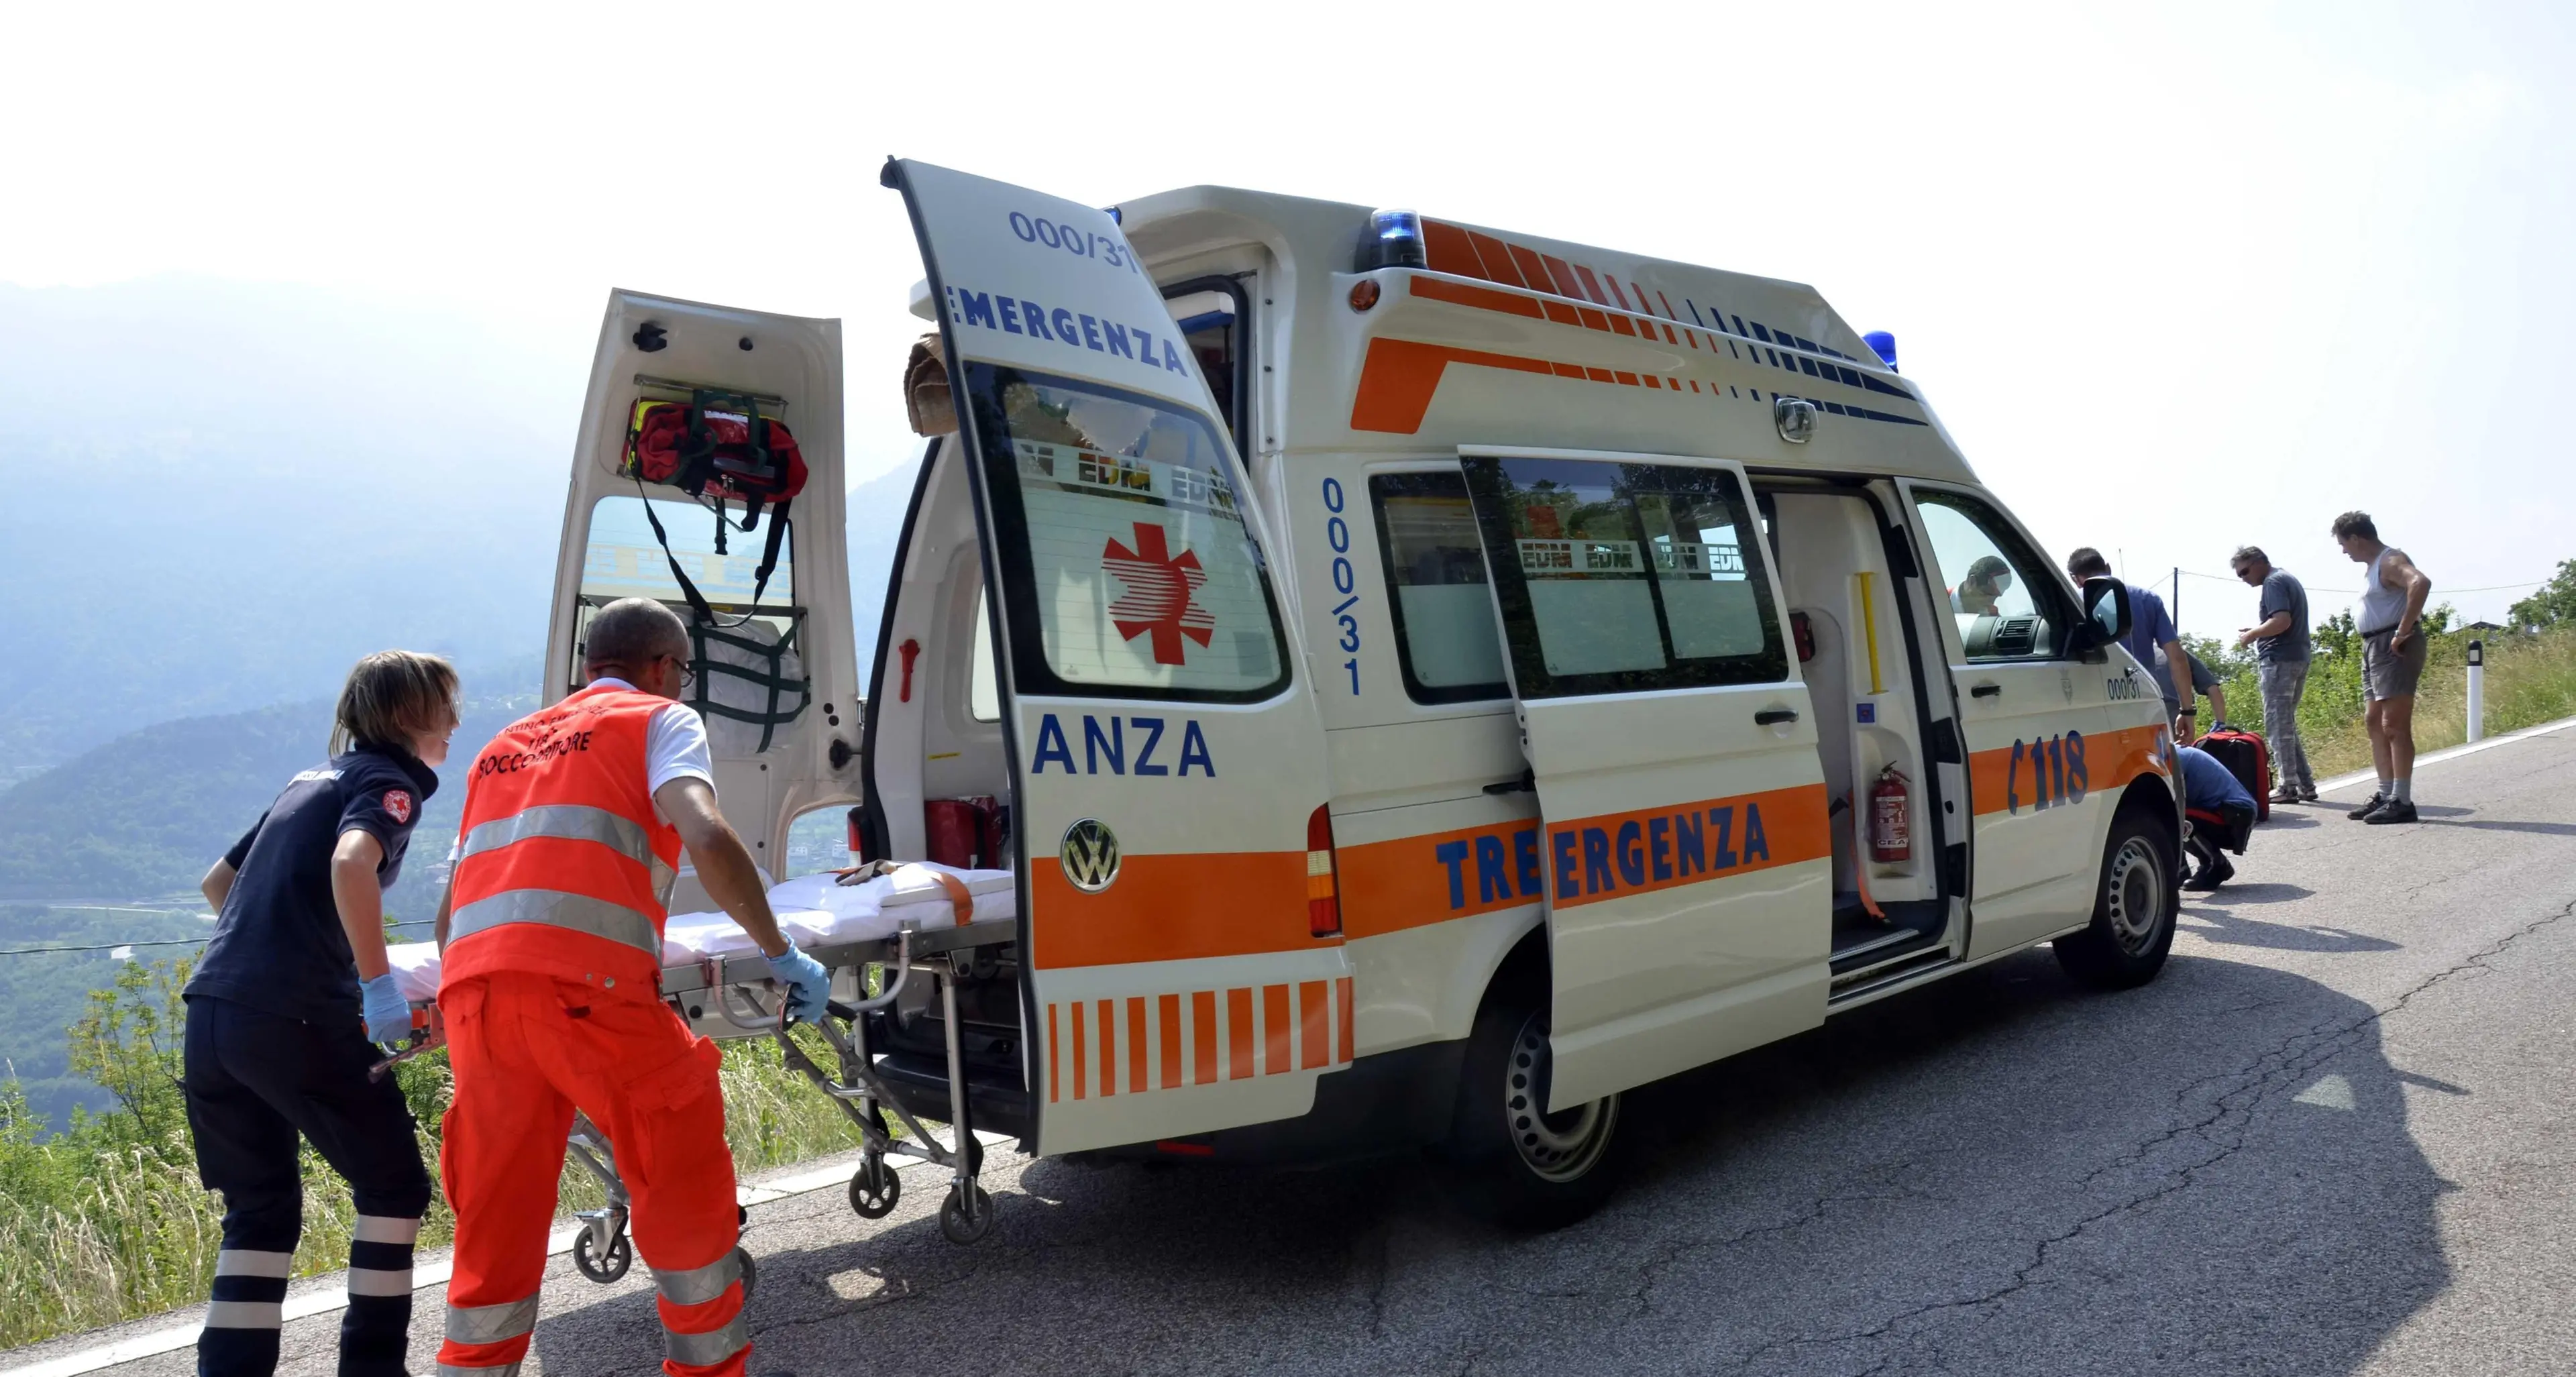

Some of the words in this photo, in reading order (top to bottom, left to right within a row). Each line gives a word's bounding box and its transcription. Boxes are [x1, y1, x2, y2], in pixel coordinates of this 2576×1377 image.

[1009, 211, 1138, 274] 000/31
[1079, 452, 1150, 492] EDM
[1322, 477, 1360, 696] 000/31
[1521, 543, 1572, 568] EDM
[1585, 543, 1633, 568] EDM
[2107, 677, 2141, 700] 000/31
[1031, 714, 1216, 777] ANZA
[2031, 730, 2088, 812] 118
[1436, 829, 1542, 910] TRE
[1553, 803, 1770, 899] ERGENZA
